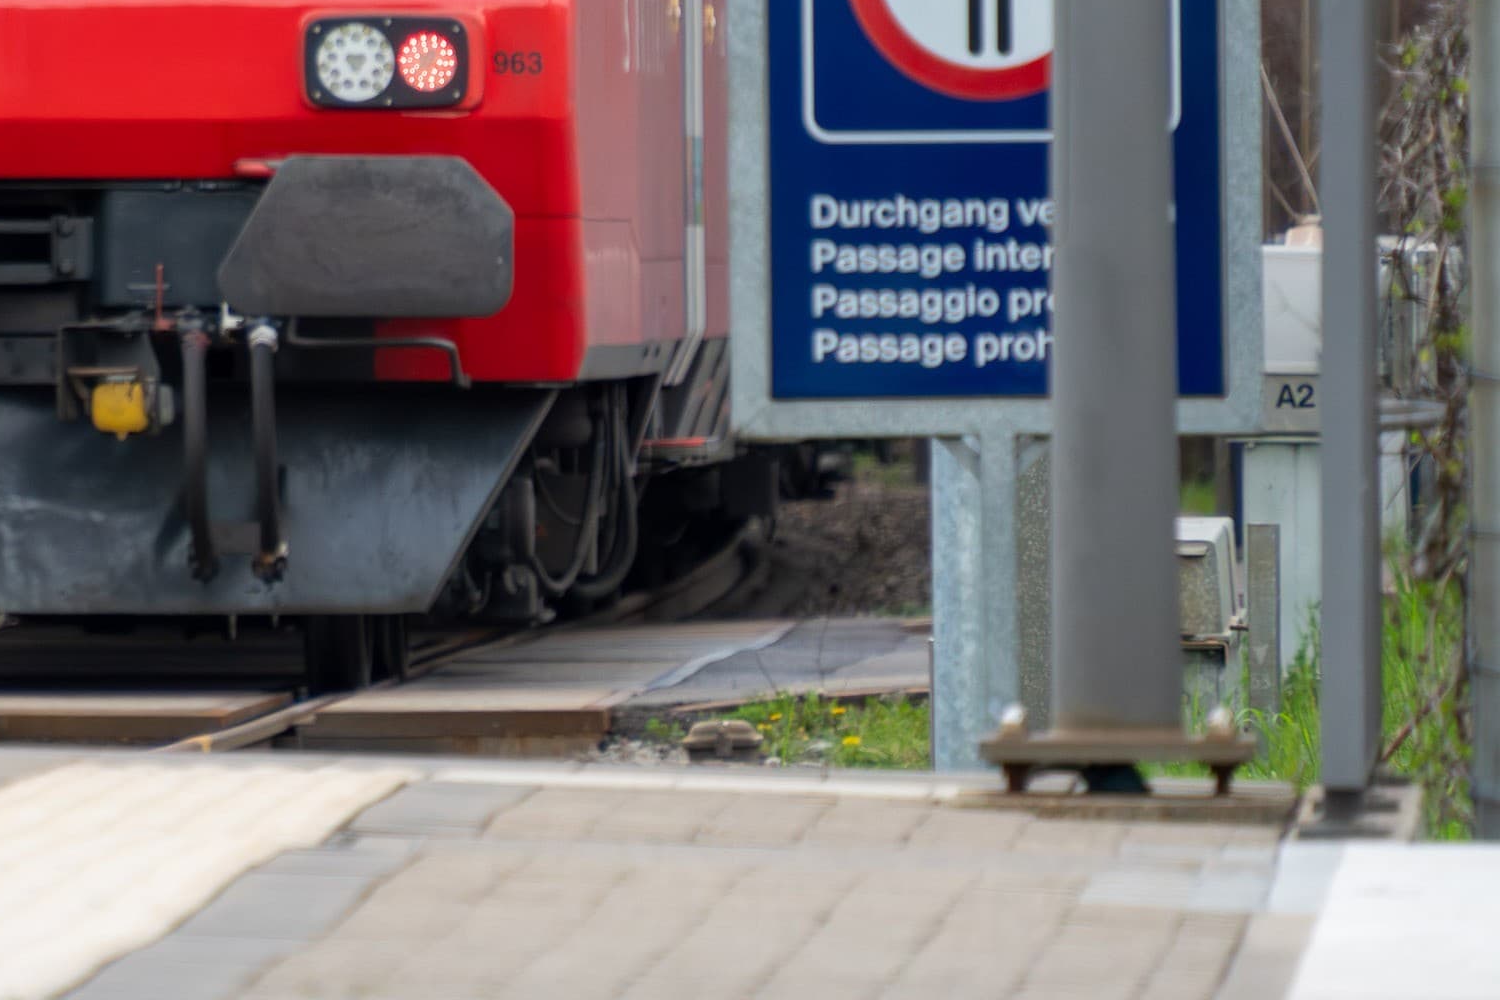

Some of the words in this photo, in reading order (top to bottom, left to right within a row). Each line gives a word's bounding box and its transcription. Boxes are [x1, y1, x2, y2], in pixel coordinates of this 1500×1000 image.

[493, 51, 543, 75] 963
[811, 194, 1010, 234] Durchgang
[811, 239, 966, 279] Passage
[811, 282, 1000, 325] Passaggio
[812, 329, 968, 368] Passage
[1275, 383, 1317, 409] A2
